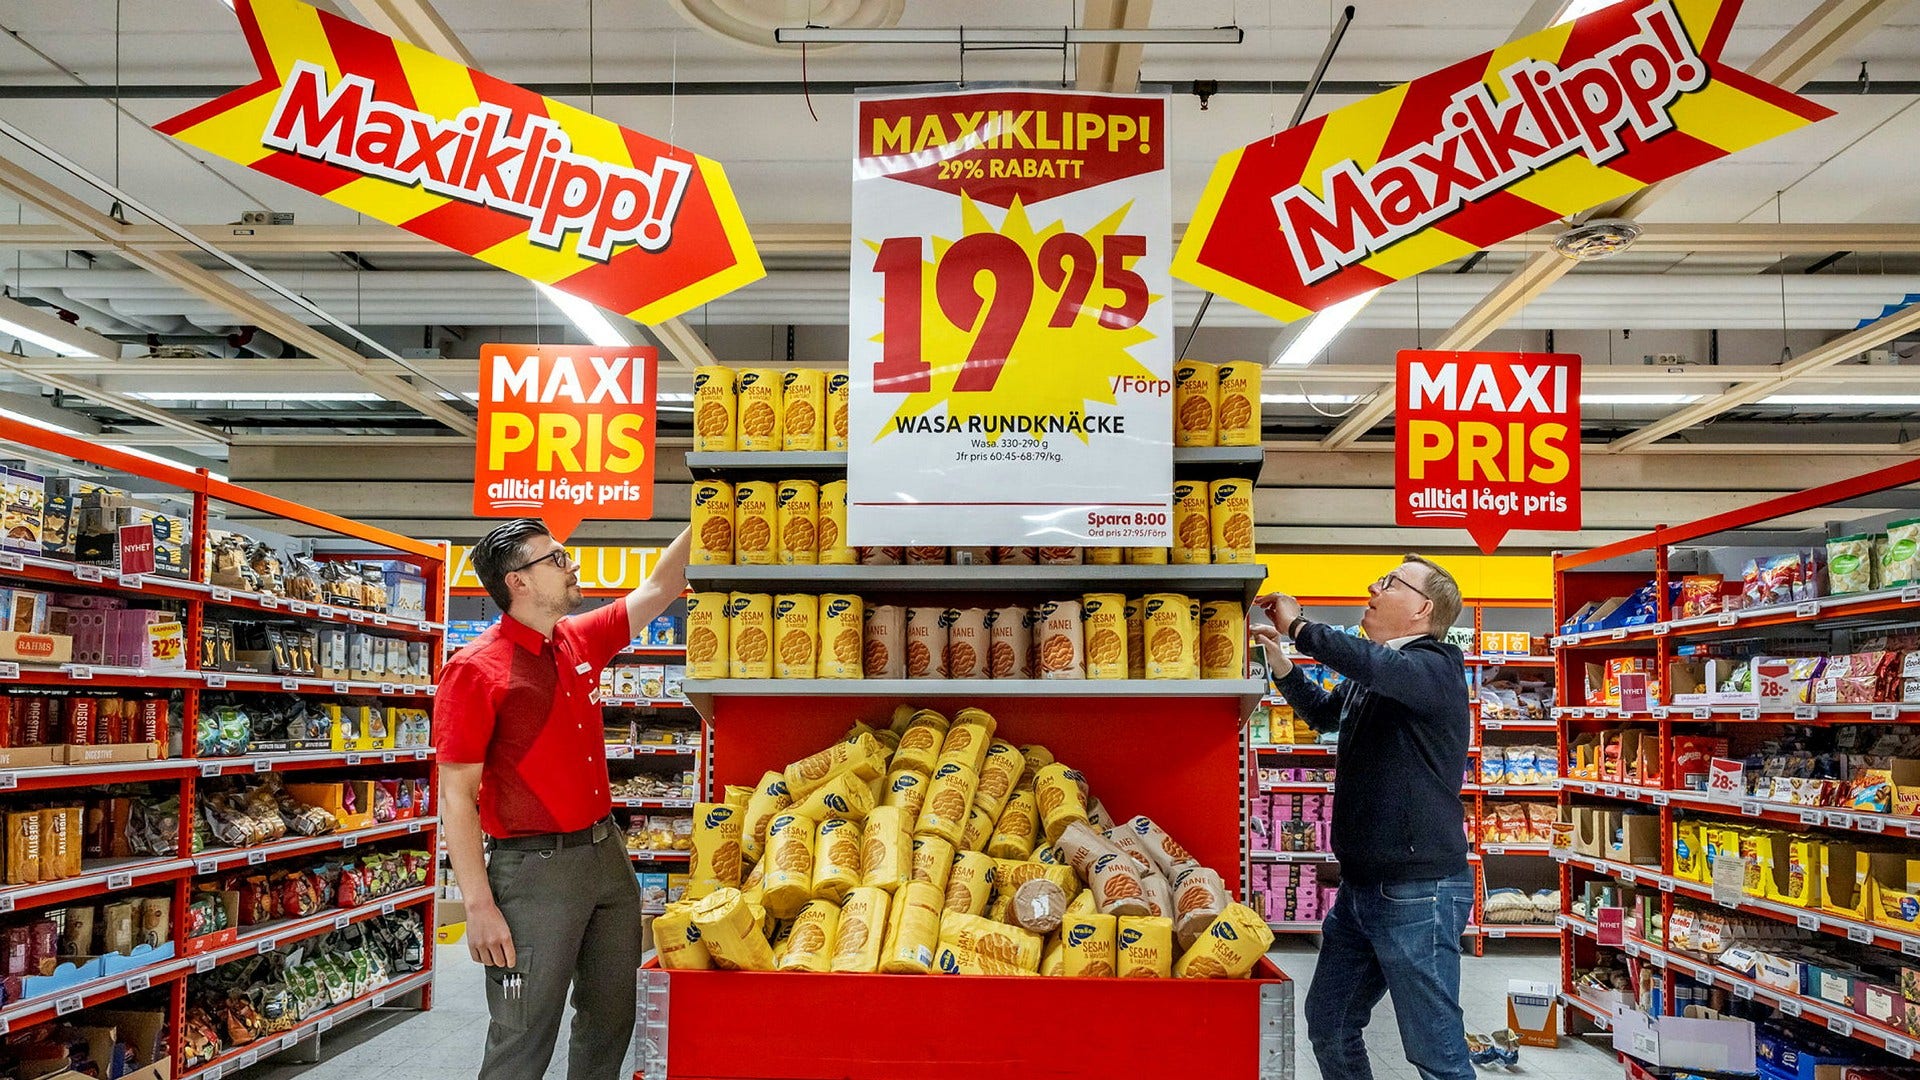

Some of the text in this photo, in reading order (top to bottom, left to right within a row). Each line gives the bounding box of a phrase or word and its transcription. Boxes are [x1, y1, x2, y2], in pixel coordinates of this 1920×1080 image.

[872, 110, 1150, 155] MAXIKLIPP!
[1279, 7, 1700, 275] Maxiklipp!
[268, 64, 686, 255] Maxiklipp!
[938, 159, 1084, 180] 29% RABATT
[491, 355, 645, 404] MAXI
[1112, 375, 1171, 397] /Förp
[1409, 362, 1568, 413] MAXI
[895, 411, 1125, 434] WASA RUNDKNÄCKE
[489, 412, 645, 473] PRIS
[1001, 439, 1038, 448] 330-290
[1040, 441, 1049, 450] g
[1409, 420, 1570, 483] PRIS
[956, 452, 969, 462] Jfr
[970, 452, 988, 463] pris
[487, 477, 640, 505] alltid lågt pris
[1409, 487, 1567, 516] alltid lågt pris
[1088, 512, 1167, 527] Spara 8:00
[1088, 529, 1167, 539] Ord pris 27:95/Förp
[124, 543, 150, 552] NYHET
[1048, 620, 1073, 630] KANEL
[18, 641, 52, 651] RAHMS
[1761, 681, 1789, 697] 28:-
[76, 703, 88, 744] DIGESTIVE
[145, 703, 157, 743] DIGESTIVE
[85, 749, 113, 760] DIGESTIVE
[1712, 773, 1738, 790] 28:-
[28, 815, 39, 859] DIGESTIVE
[912, 855, 935, 866] ESAM
[1670, 918, 1690, 929] nutella
[1699, 922, 1720, 935] nutella
[1083, 941, 1110, 952] SESAM
[1128, 946, 1157, 958] SESAM
[1214, 939, 1242, 965] SESAM
